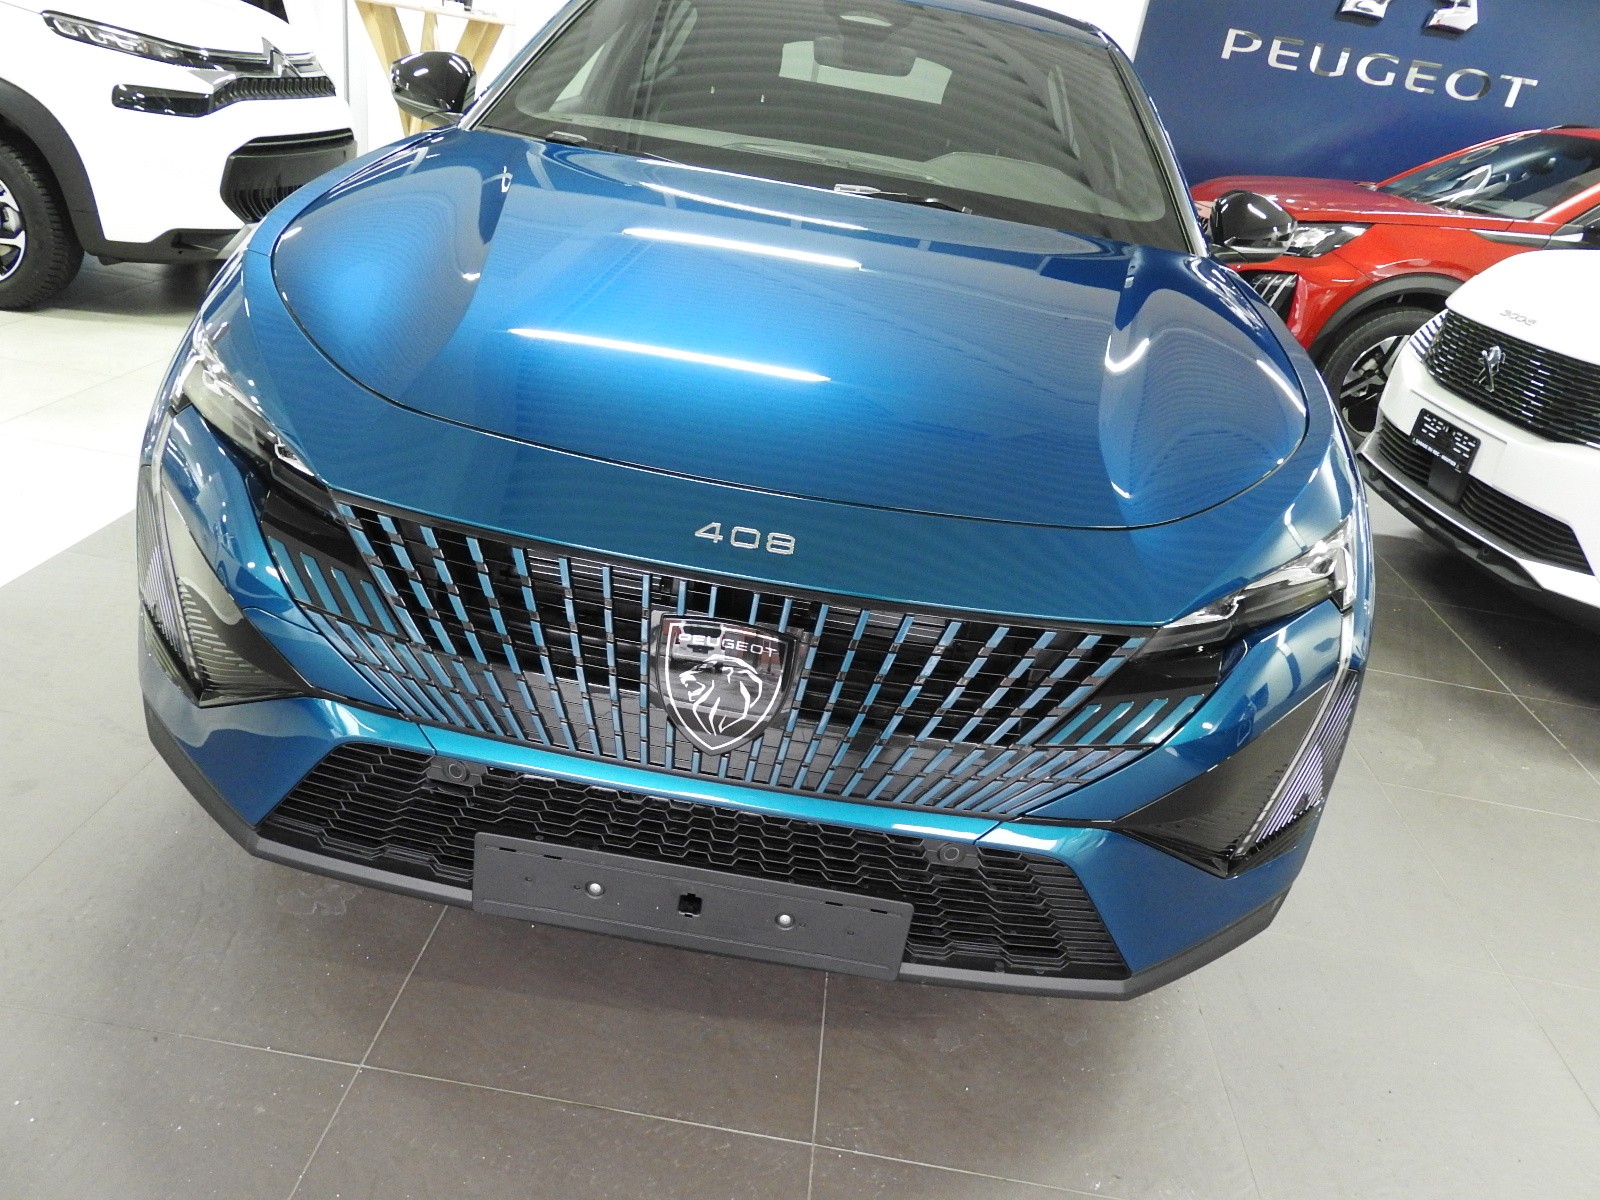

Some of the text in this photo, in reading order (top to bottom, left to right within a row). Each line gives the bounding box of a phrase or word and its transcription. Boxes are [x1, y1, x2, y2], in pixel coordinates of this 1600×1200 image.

[1221, 28, 1539, 108] PEUGEOT
[694, 522, 796, 555] 408
[678, 633, 779, 658] PEUGEOT
